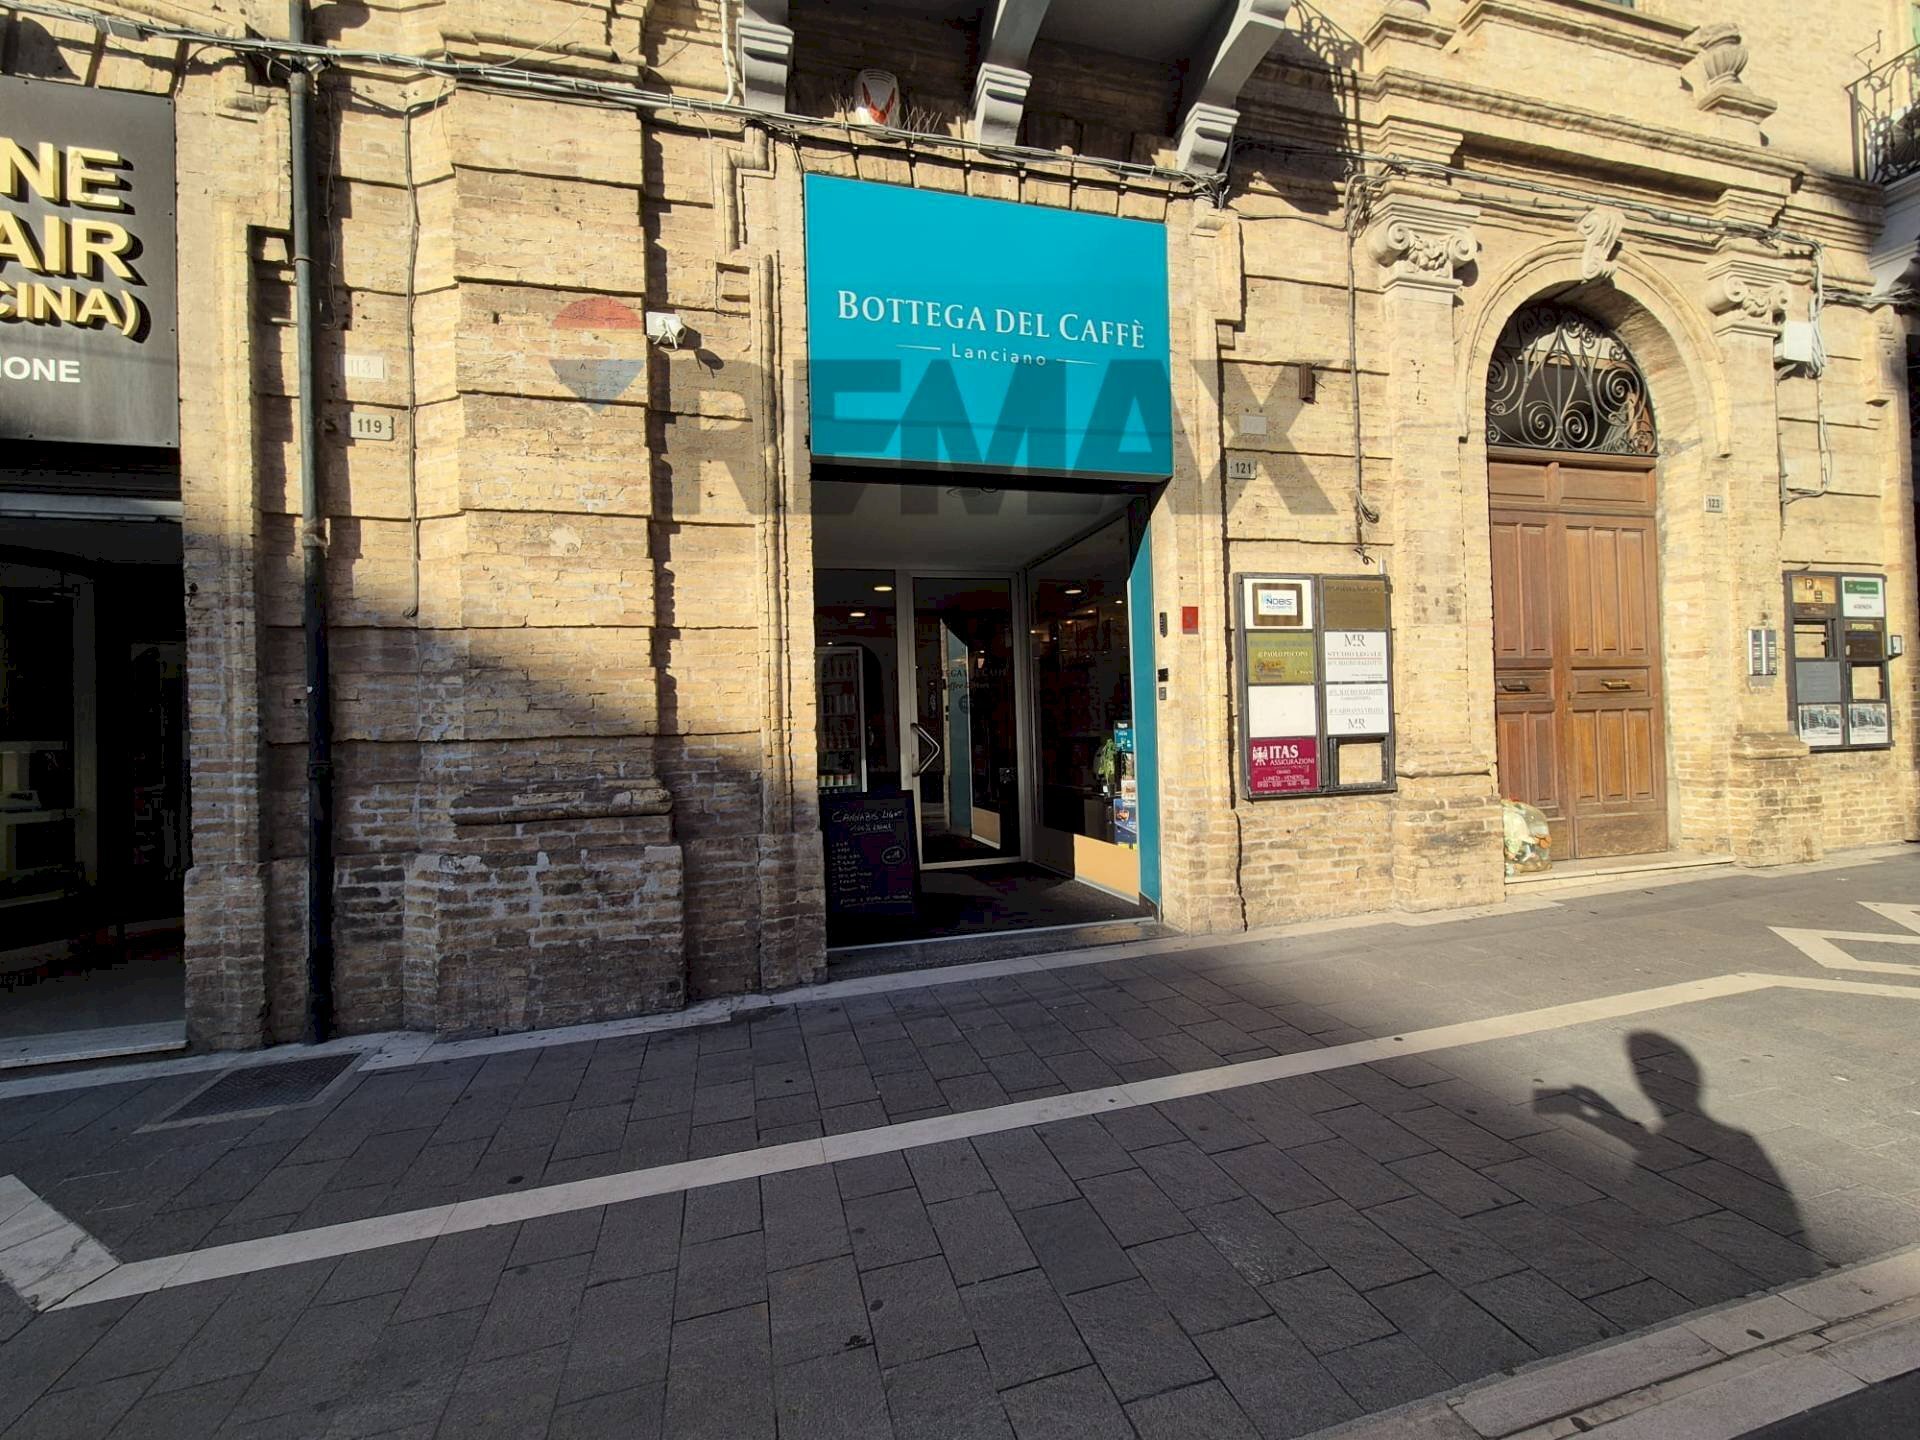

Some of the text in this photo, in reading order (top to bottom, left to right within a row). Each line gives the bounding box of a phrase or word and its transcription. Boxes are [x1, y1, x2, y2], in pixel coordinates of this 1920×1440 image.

[837, 289, 1145, 349] BOTTEGA DEL CAFFÈ
[951, 343, 1047, 366] Lanciano
[0, 354, 81, 383] ONE
[357, 418, 383, 434] 119
[1235, 461, 1252, 475] 121
[1269, 744, 1299, 759] ITAS
[1270, 758, 1315, 766] ASSICURAZIONI
